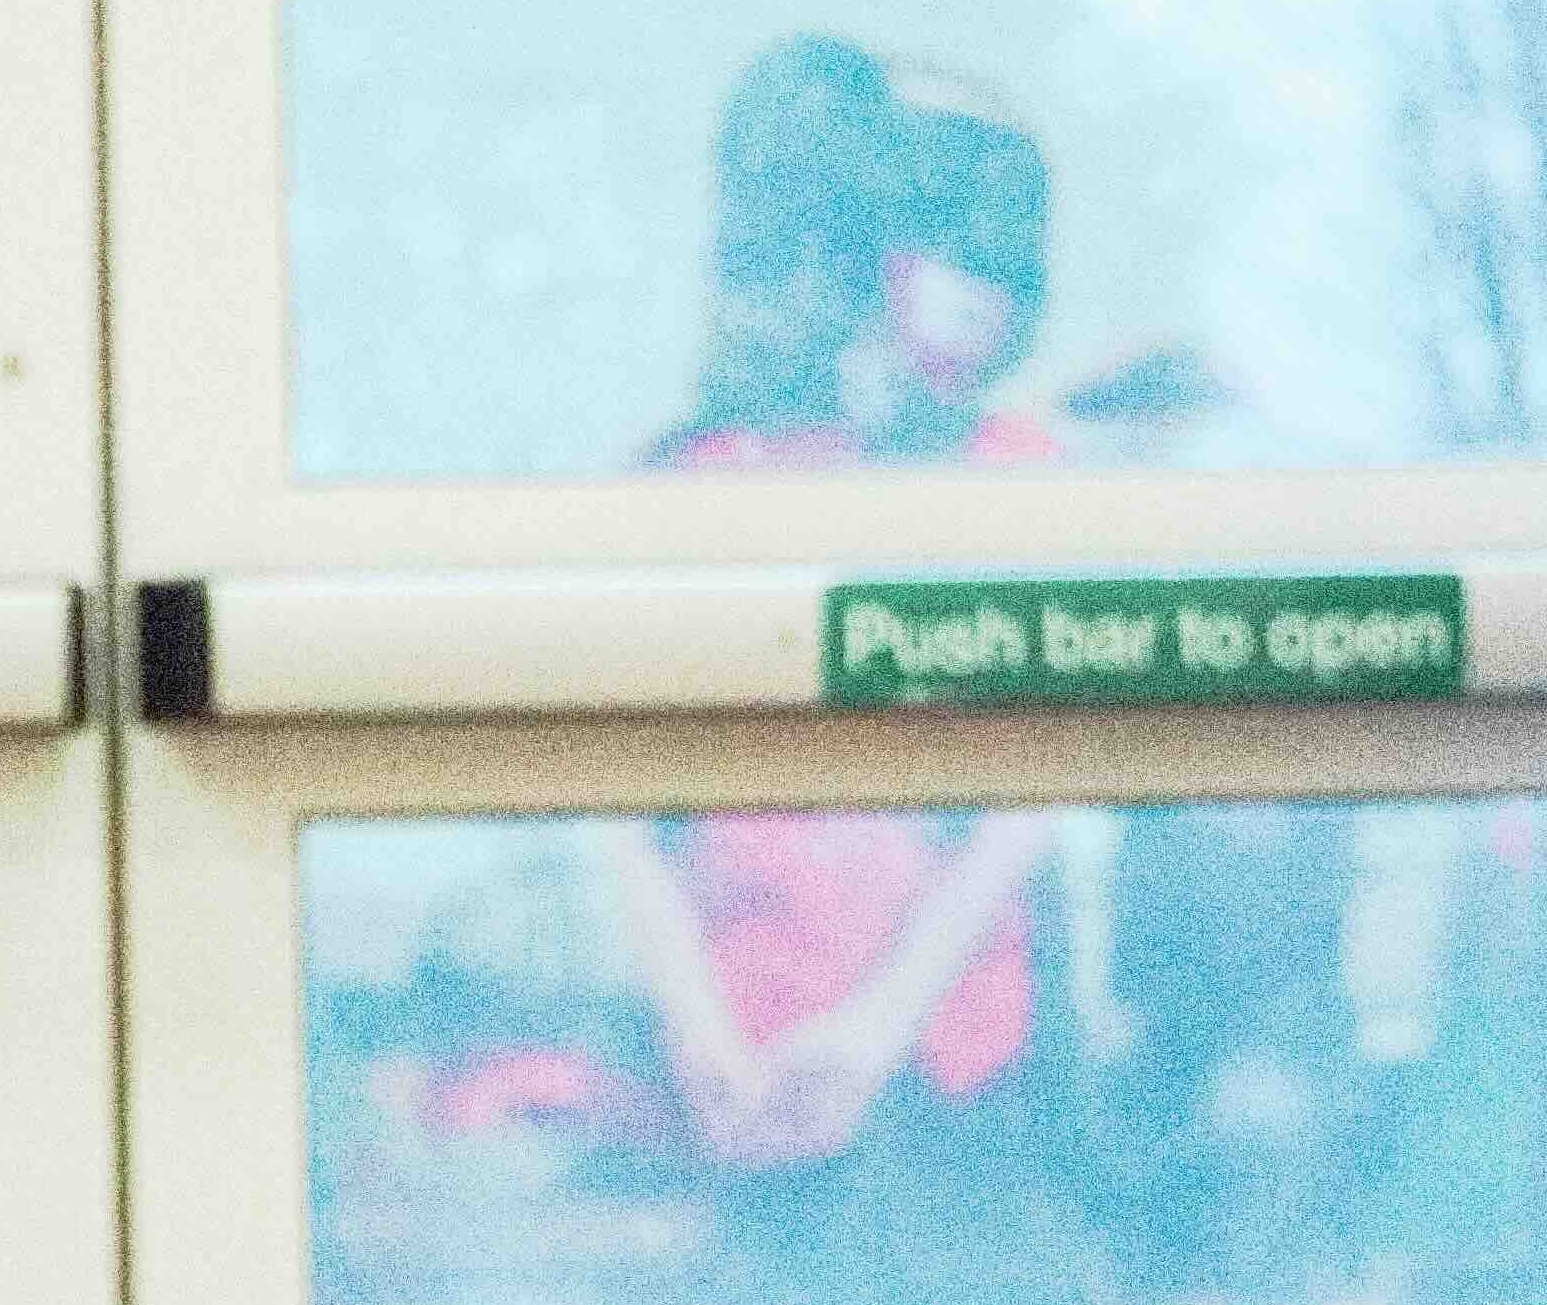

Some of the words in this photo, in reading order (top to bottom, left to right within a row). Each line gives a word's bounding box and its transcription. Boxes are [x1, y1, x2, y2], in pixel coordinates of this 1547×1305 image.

[843, 603, 1028, 673] Push
[1044, 604, 1154, 672] bar
[1179, 604, 1251, 671] to
[1268, 607, 1448, 681] open
